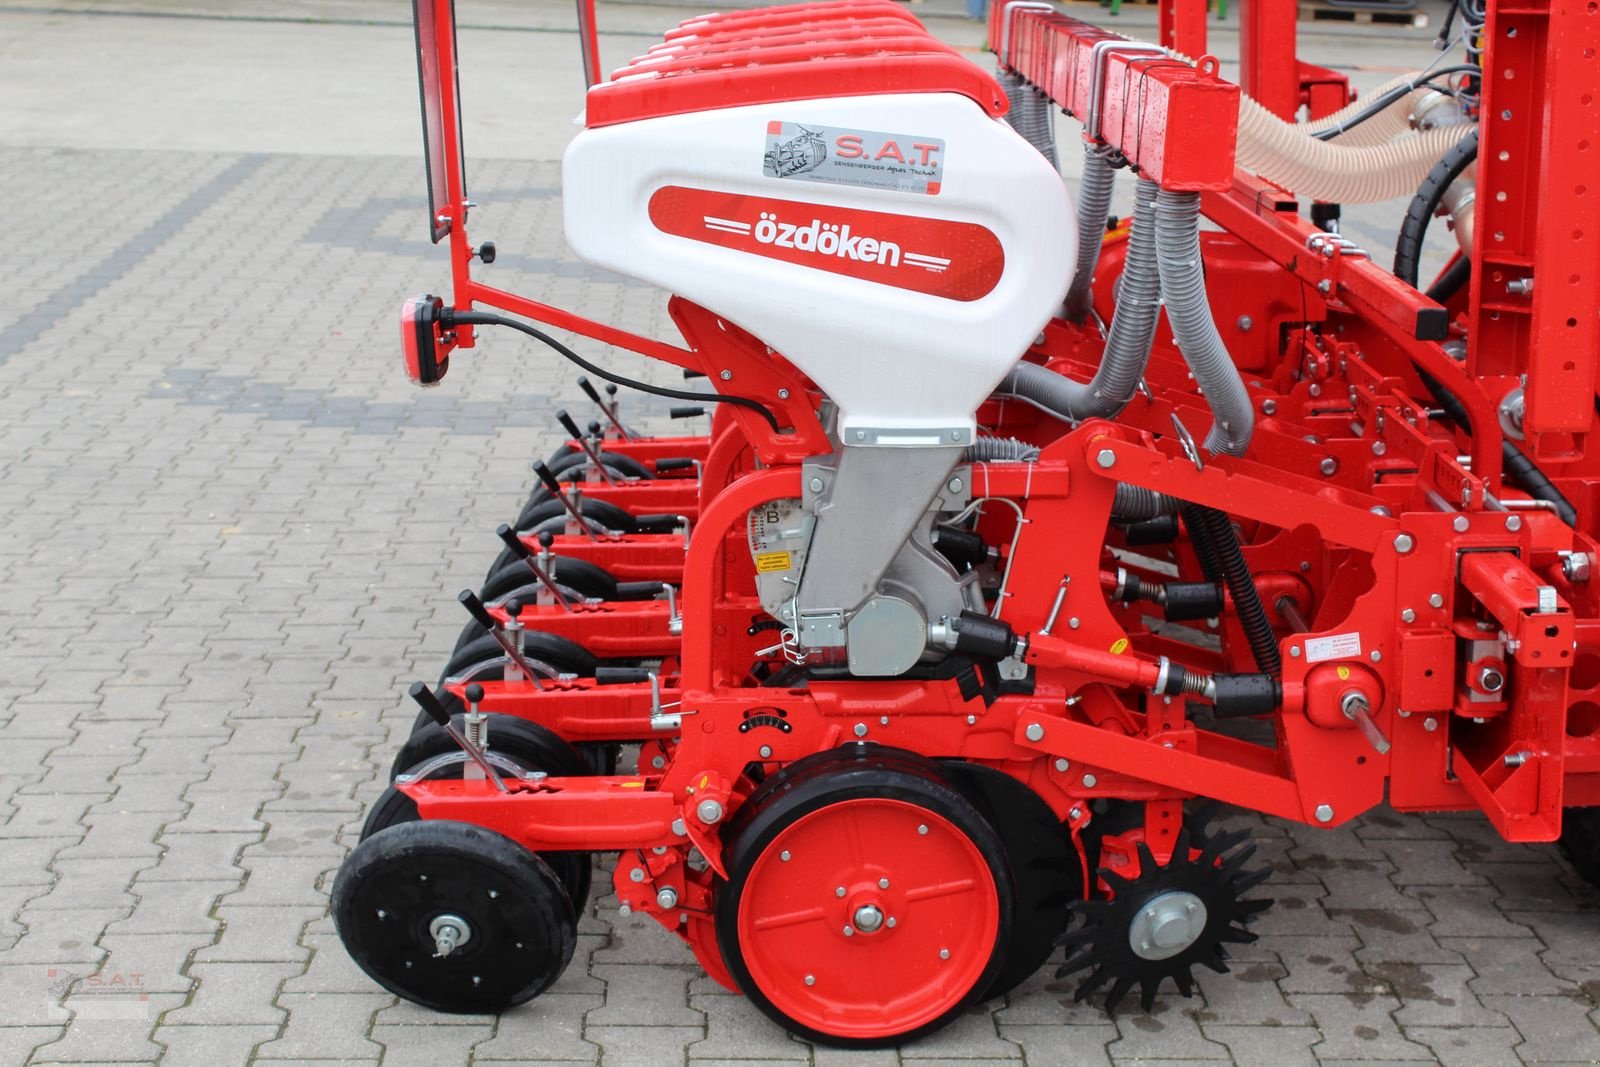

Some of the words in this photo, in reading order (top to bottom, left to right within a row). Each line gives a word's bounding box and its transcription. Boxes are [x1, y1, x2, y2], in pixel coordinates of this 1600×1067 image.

[835, 134, 939, 168] S.A.T.
[833, 160, 885, 171] SENSENBERGER
[754, 211, 901, 268] özdöken
[766, 511, 780, 524] B
